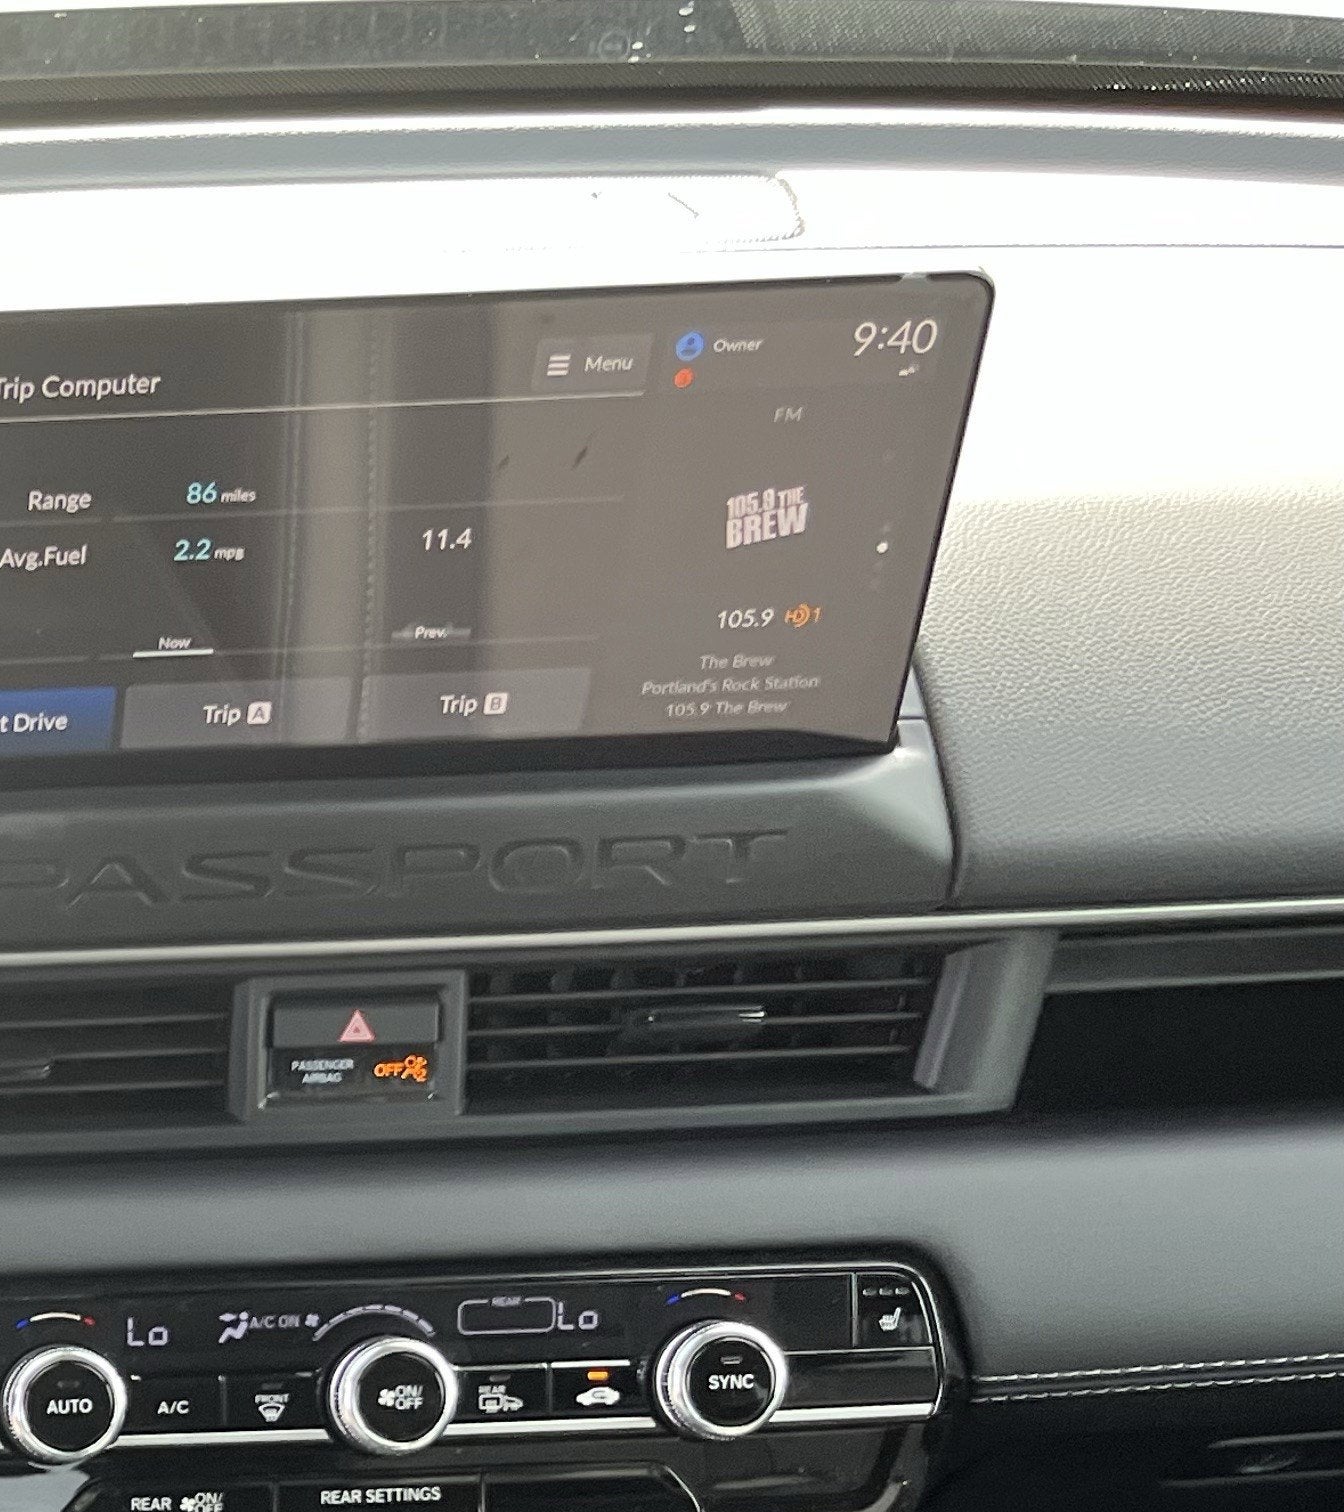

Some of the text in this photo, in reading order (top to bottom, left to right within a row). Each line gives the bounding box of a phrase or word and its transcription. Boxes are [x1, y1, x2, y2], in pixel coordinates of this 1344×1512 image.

[713, 336, 764, 353] Owner
[852, 318, 938, 357] 9:40
[584, 355, 634, 374] Menu
[41, 373, 161, 400] Computer
[773, 406, 804, 424] FM
[27, 482, 256, 514] Range 86 miles
[726, 486, 805, 519] 105.9 THE
[725, 502, 809, 550] BREW
[173, 539, 211, 562] 2.2
[214, 546, 245, 562] mpg
[421, 528, 473, 551] 11.4
[717, 607, 776, 631] 105.9
[158, 636, 191, 650] Now
[700, 654, 775, 670] The Brew
[641, 675, 819, 695] Portland's Rock Station
[203, 703, 242, 726] Trip
[440, 694, 478, 716] Trip
[716, 701, 743, 714] The
[747, 700, 789, 714] Brew
[12, 712, 69, 734] Drive
[291, 1058, 354, 1072] PASSENGER
[374, 1061, 405, 1077] OFF
[394, 1384, 423, 1398] ON/
[708, 1373, 755, 1390] SYNC
[46, 1397, 93, 1416] AUTO
[157, 1399, 189, 1415] A/C
[394, 1397, 423, 1410] OFF
[130, 1496, 172, 1512] REAR
[195, 1491, 223, 1505] ON/
[320, 1485, 441, 1505] REAR SETTINGS
